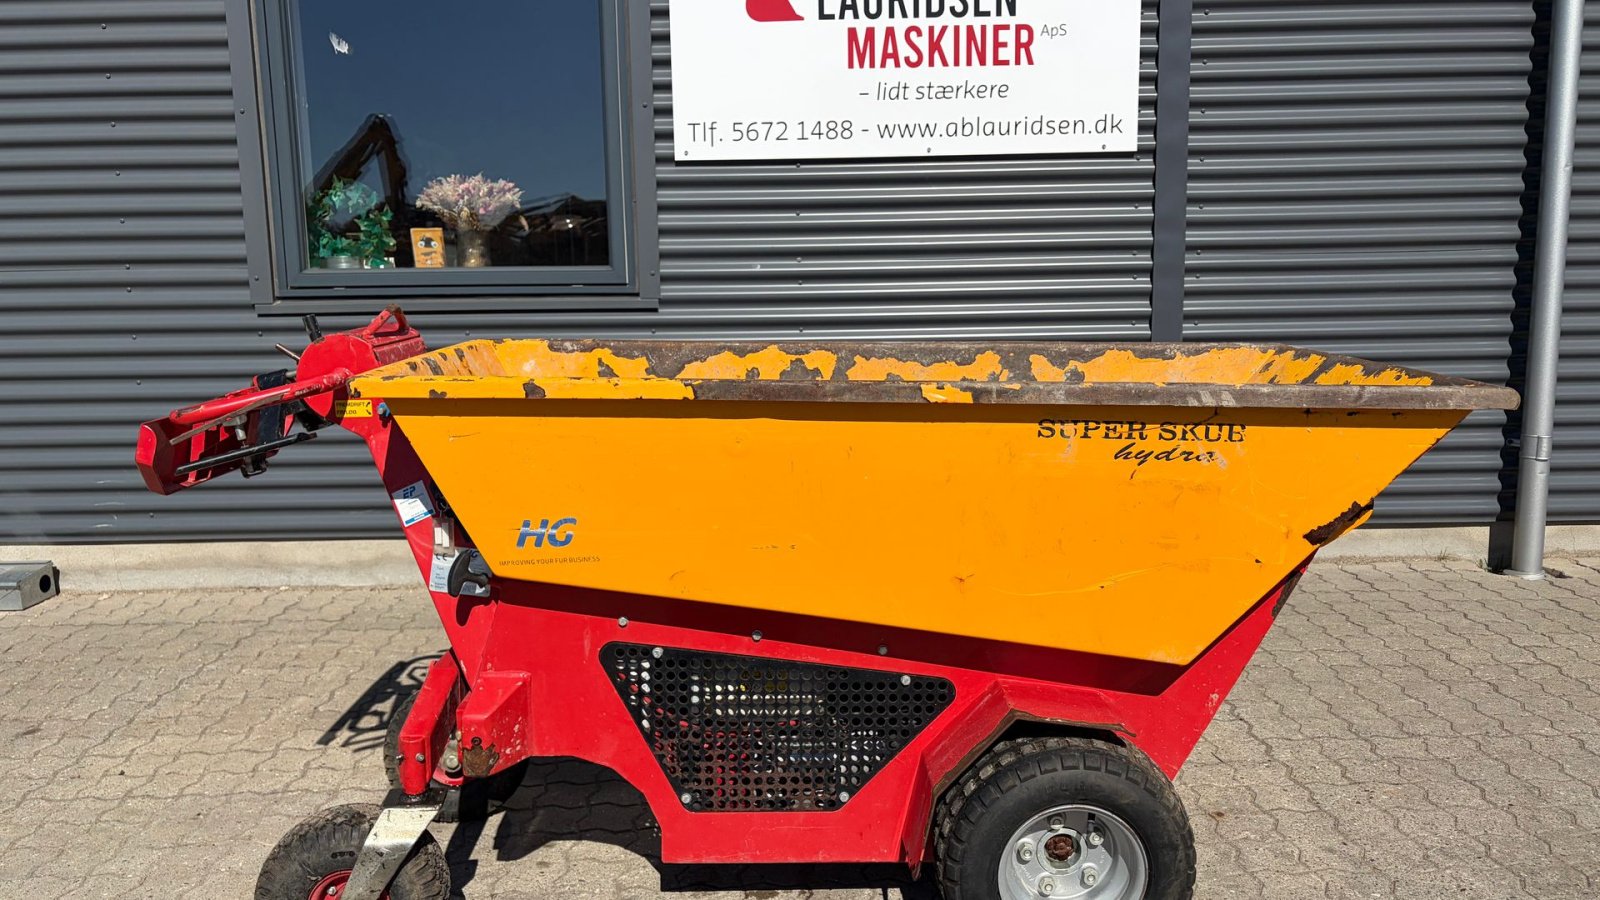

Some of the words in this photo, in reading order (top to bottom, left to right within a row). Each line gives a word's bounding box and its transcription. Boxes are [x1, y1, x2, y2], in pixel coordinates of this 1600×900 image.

[1040, 24, 1067, 39] ApS
[847, 24, 1035, 69] MASKINER
[877, 82, 909, 100] lidt
[915, 81, 1009, 100] stærkere
[687, 123, 722, 147] Tlf.
[732, 122, 788, 142] 5672
[797, 121, 853, 140] 1488
[877, 114, 1123, 140] www.ablauridsen.dk
[1037, 418, 1148, 441] SUPER
[1114, 442, 1218, 467] hydra
[516, 517, 577, 548] HG
[568, 555, 600, 563] BUSINESS
